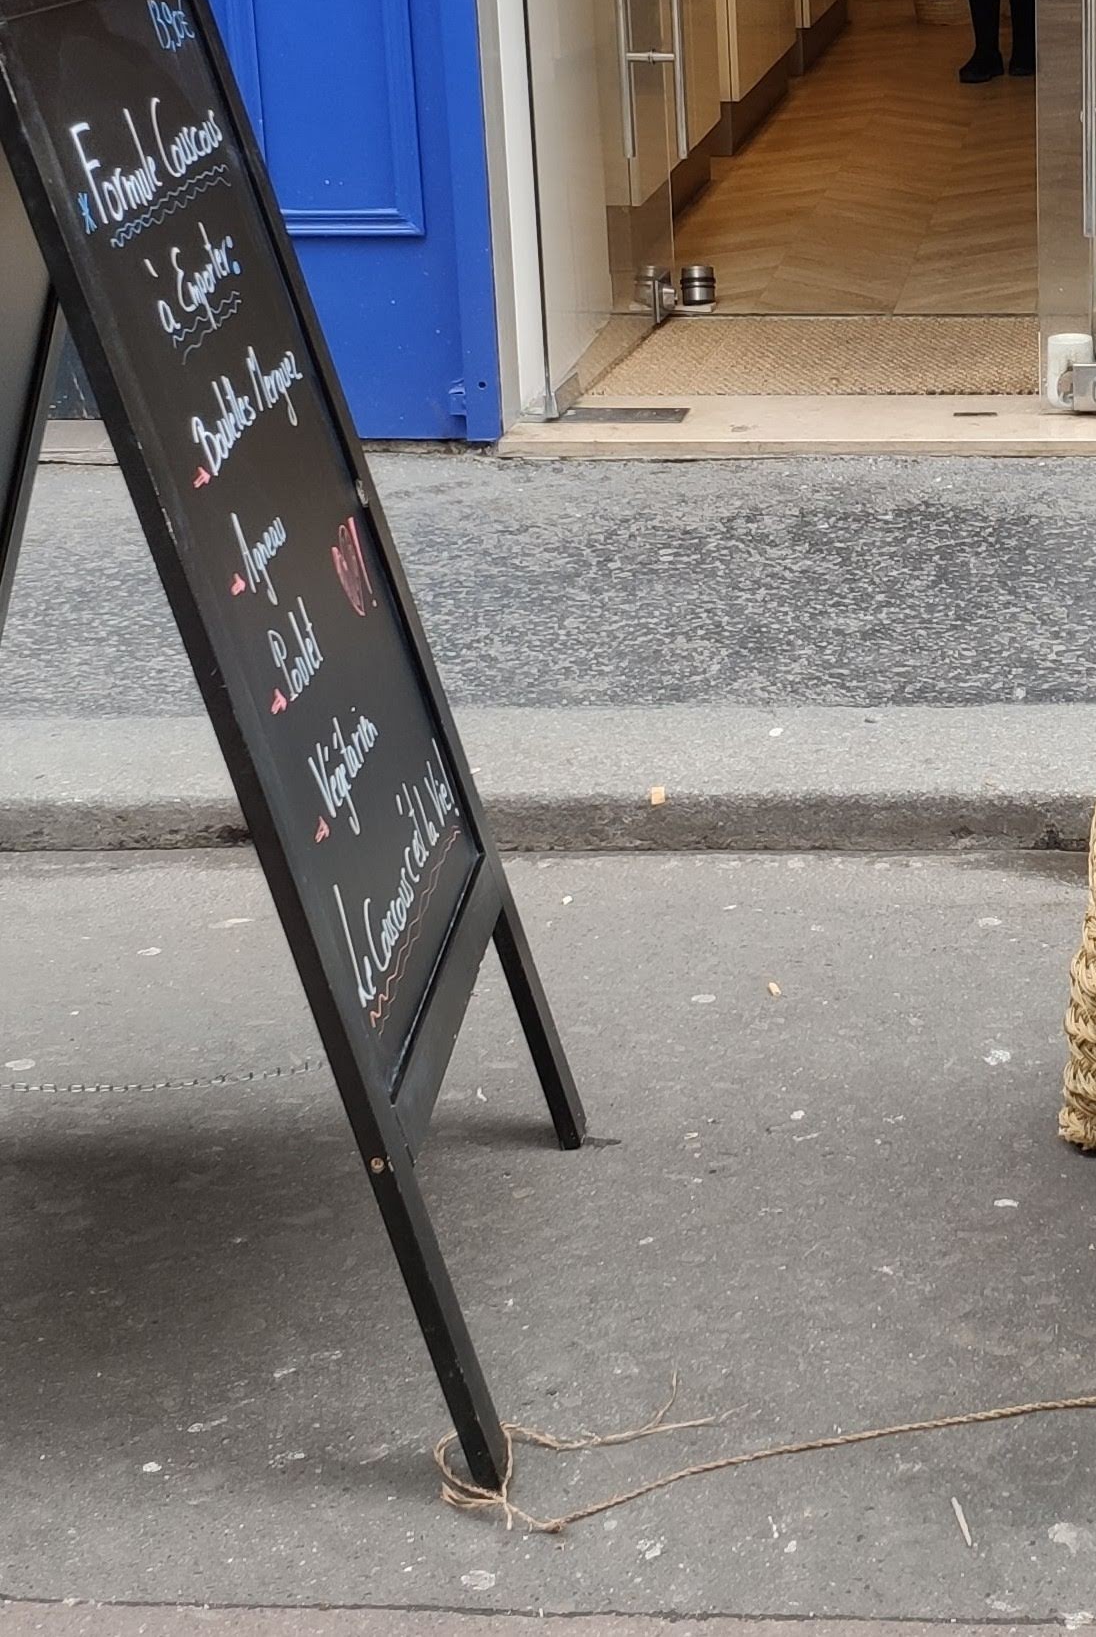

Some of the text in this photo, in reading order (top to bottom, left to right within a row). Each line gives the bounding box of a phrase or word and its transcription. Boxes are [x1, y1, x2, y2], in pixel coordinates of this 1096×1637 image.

[69, 97, 224, 225] Formule Couscous
[246, 345, 304, 427] Merguez
[230, 512, 287, 606] Agneau
[267, 595, 325, 703] Poulet
